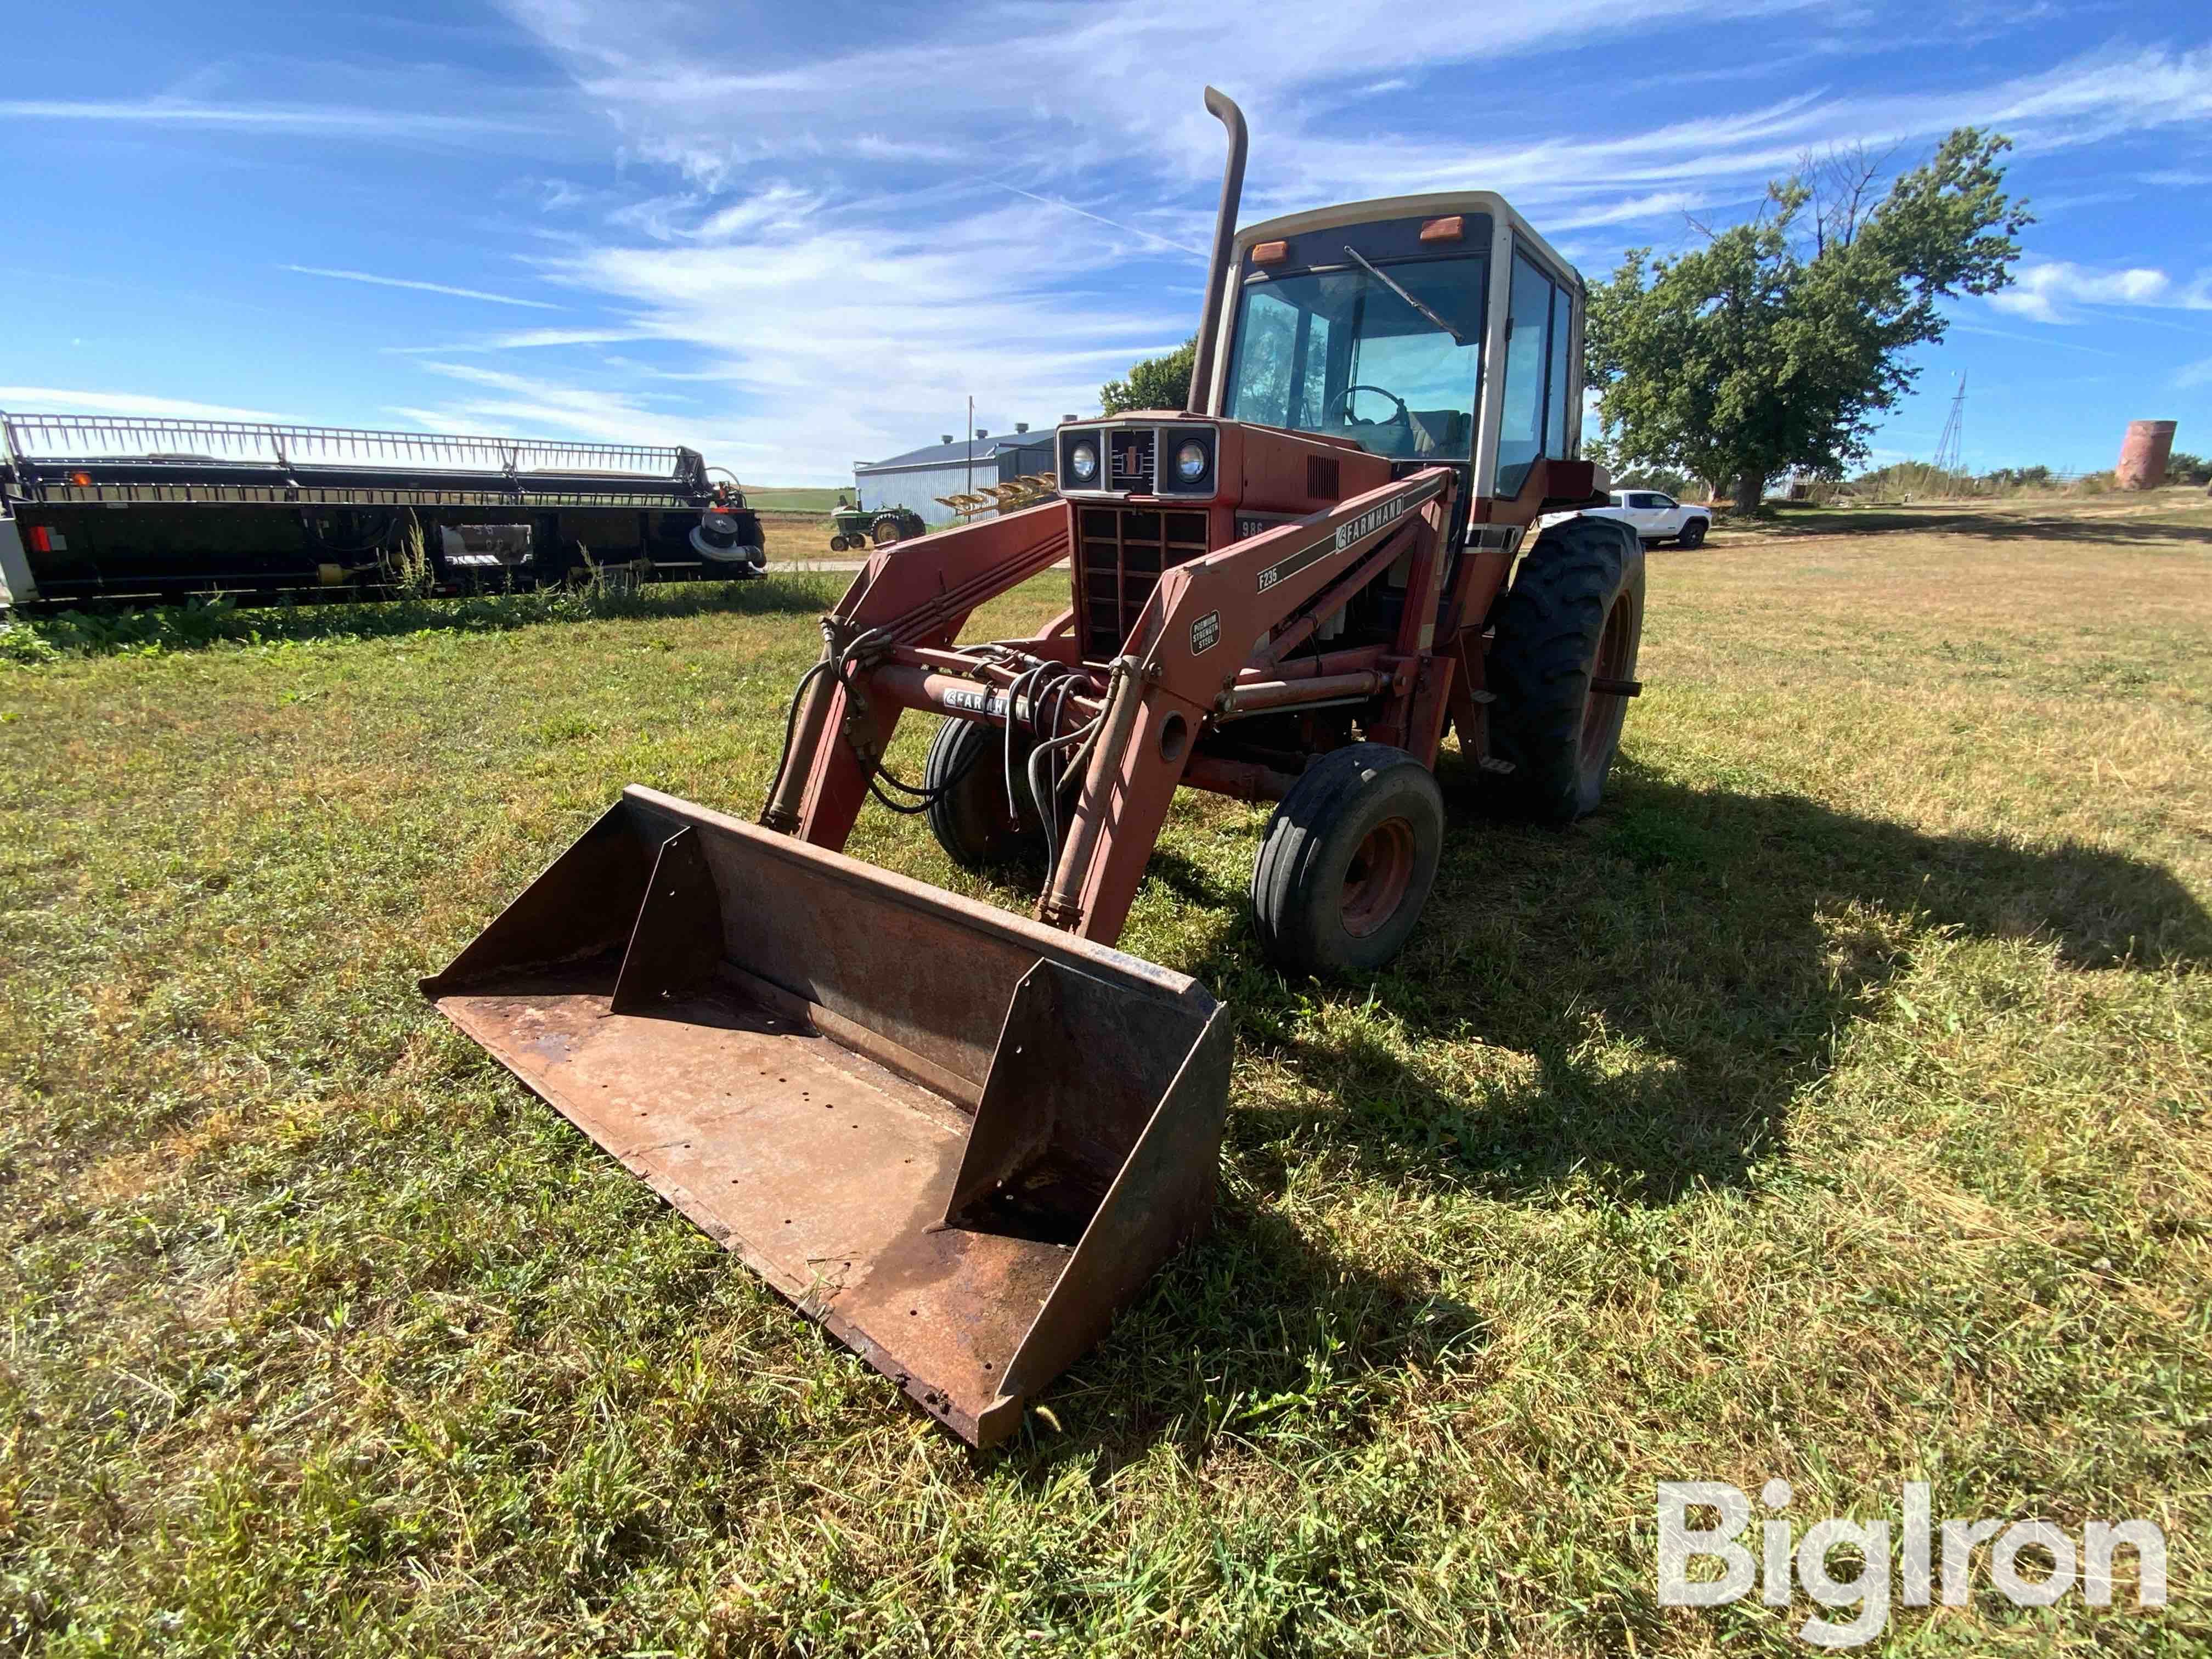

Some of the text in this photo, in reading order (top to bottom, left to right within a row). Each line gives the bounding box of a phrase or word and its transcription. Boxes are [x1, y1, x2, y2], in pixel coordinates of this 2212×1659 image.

[1242, 521, 1263, 537] 986
[1347, 498, 1402, 544] FARMHAND
[1259, 567, 1277, 589] F235
